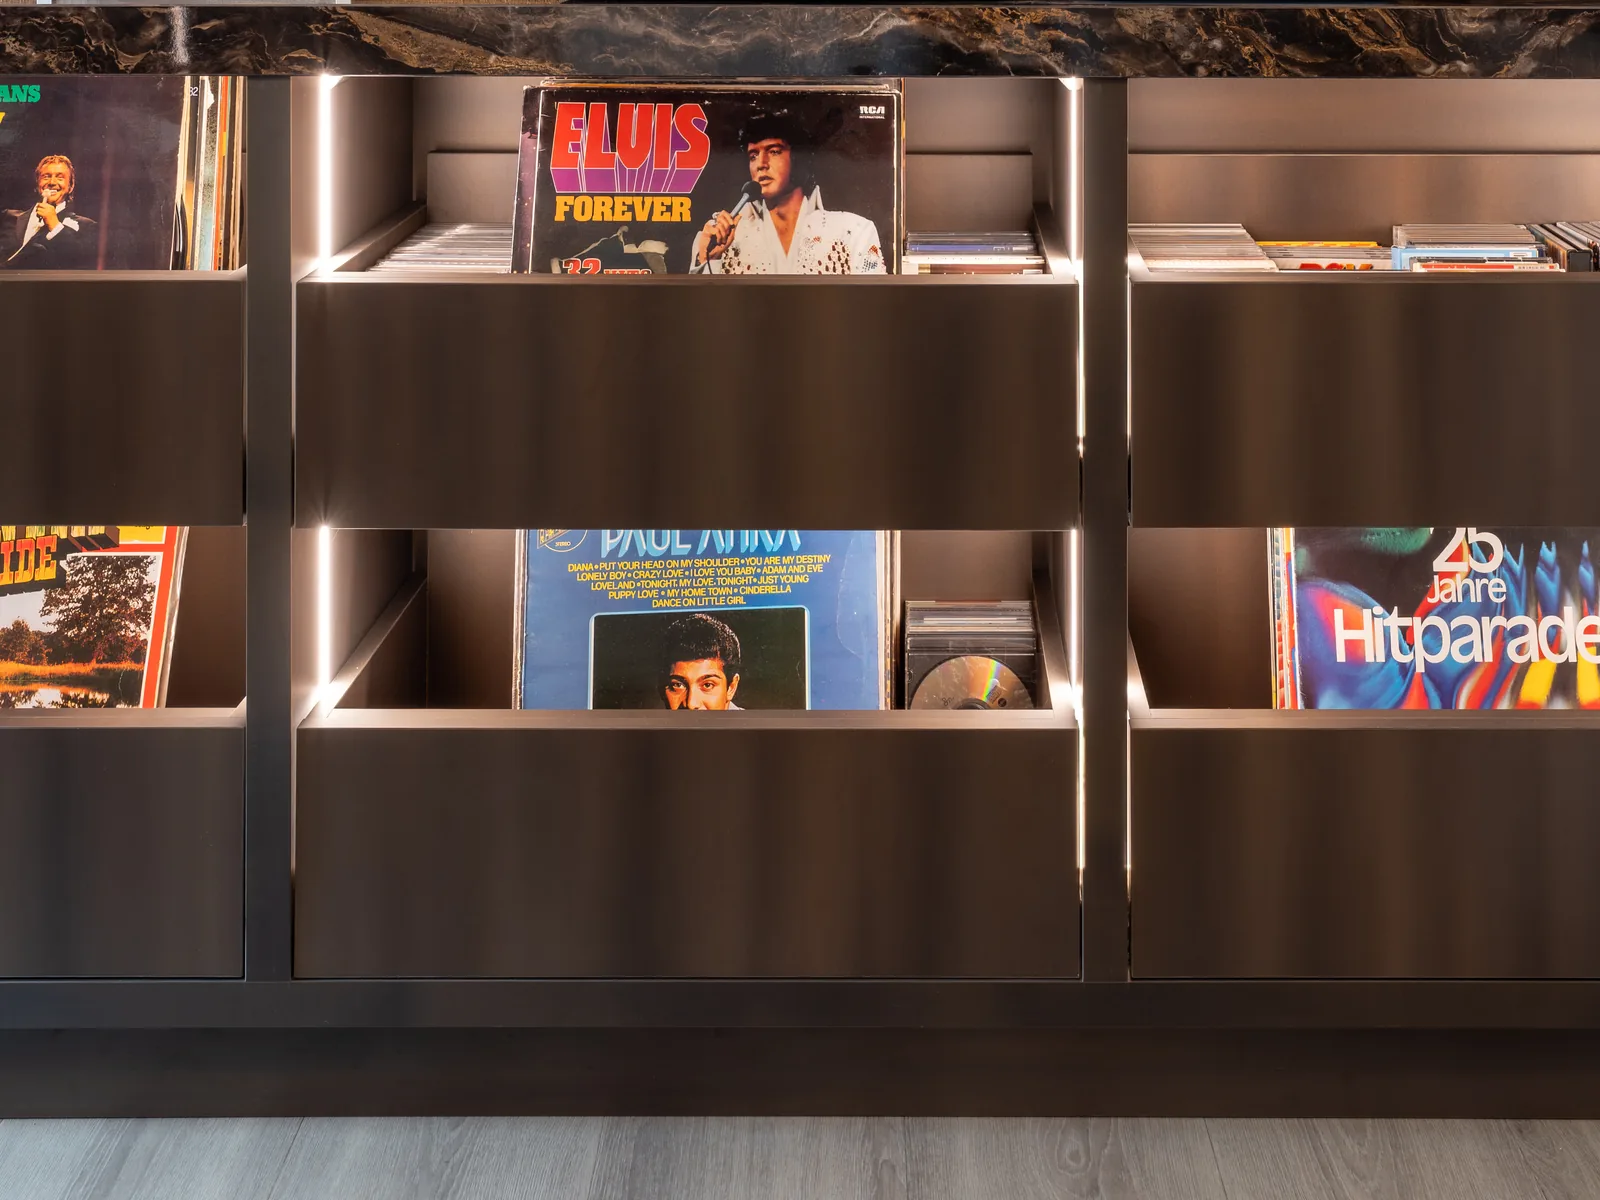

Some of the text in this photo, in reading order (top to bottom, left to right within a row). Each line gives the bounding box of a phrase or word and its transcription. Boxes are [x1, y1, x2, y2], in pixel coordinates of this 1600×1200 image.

[859, 106, 885, 114] RCA
[549, 101, 710, 194] ELVIS
[554, 195, 692, 222] FOREVER
[1431, 527, 1504, 573] 25
[568, 554, 831, 572] DIANA PUT YOUR HEAD ON MY SHOULDER YOU ARE MY DESTINY
[577, 564, 823, 581] LONELY BOY CRAZY LOVE I LOVE YOU BABY ADAM AND EVE
[591, 580, 636, 590] LOVELAND
[680, 578, 691, 587] MY
[717, 576, 753, 585] TONIGHT
[758, 575, 779, 584] JUST
[780, 574, 809, 583] YOUNG
[1427, 573, 1507, 604] Jahre
[609, 584, 791, 599] PUPPY LOVE MY HOME TOWN CINDERELLA
[652, 595, 746, 607] DANCE ON LITTLE GIRL
[1333, 606, 1600, 673] Hitparade
